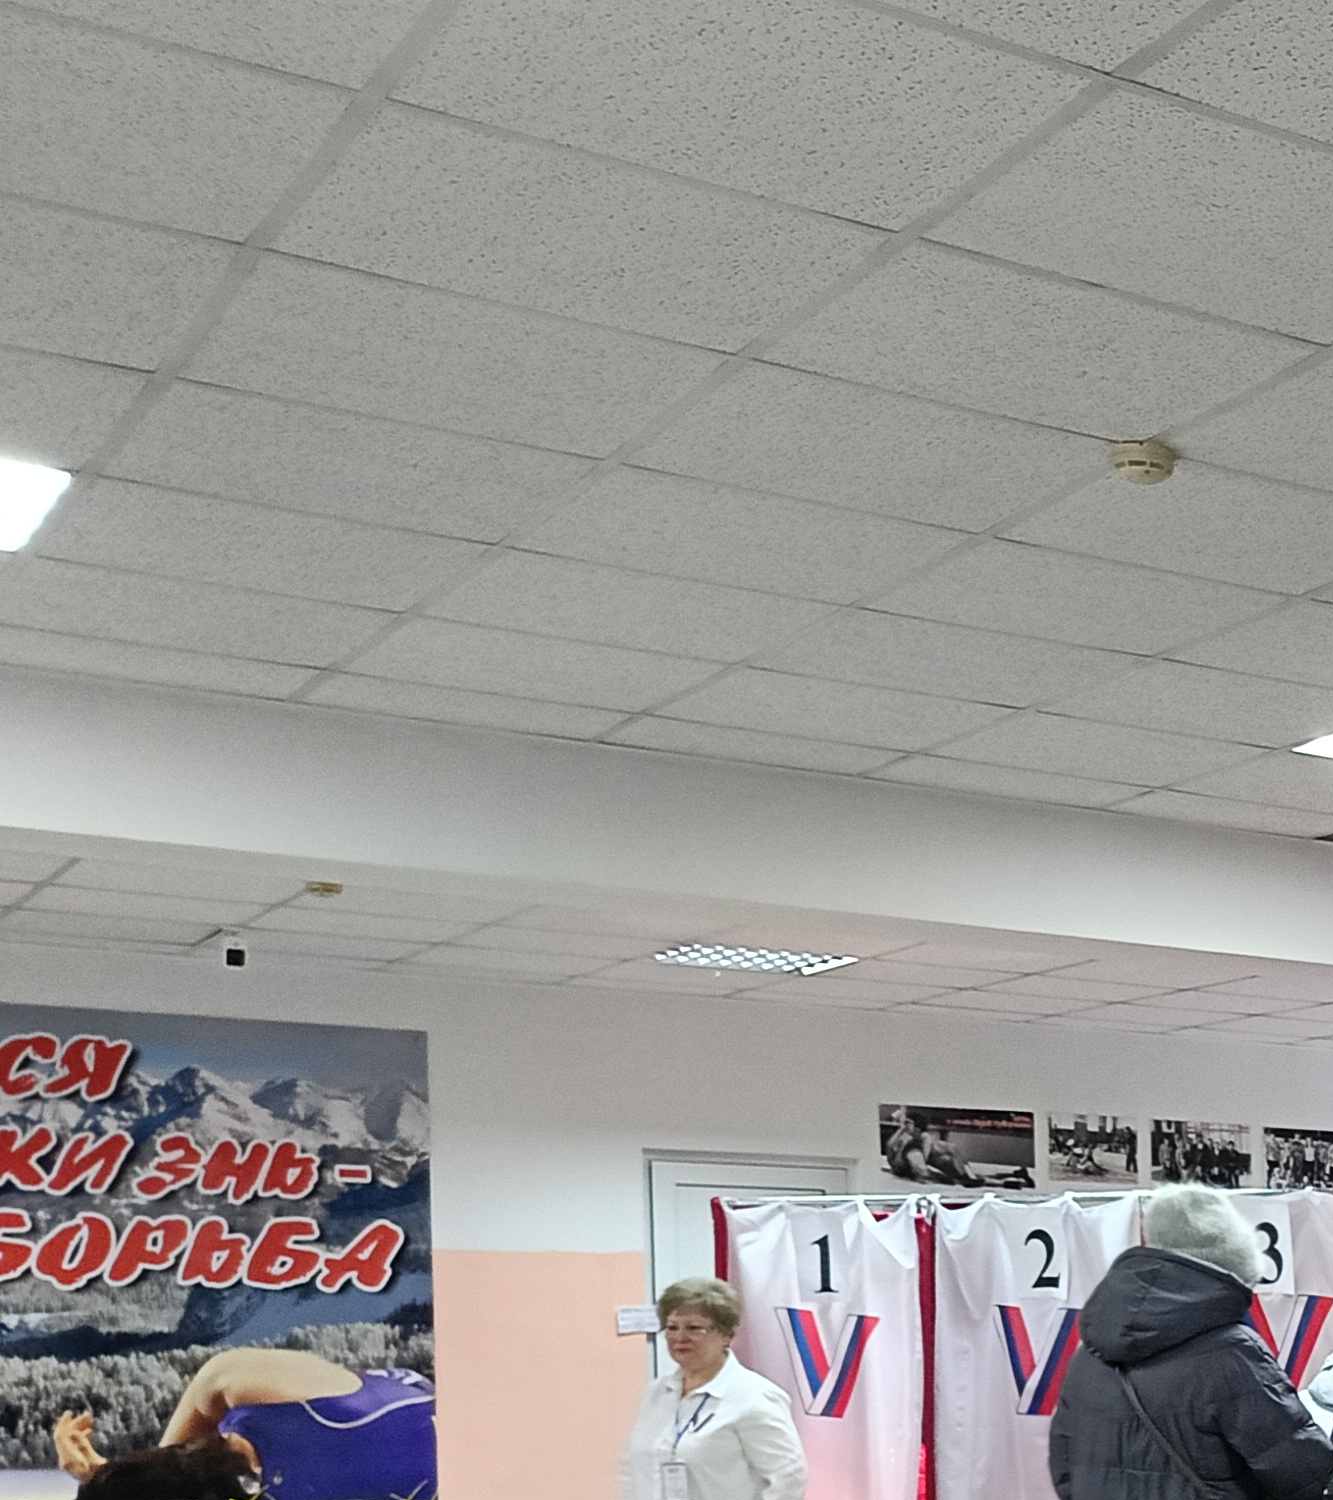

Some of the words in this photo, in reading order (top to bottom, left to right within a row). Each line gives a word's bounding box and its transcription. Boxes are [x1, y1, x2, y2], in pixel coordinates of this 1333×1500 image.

[811, 1234, 839, 1294] 1
[1024, 1229, 1061, 1289] 2
[1254, 1221, 1284, 1285] 3
